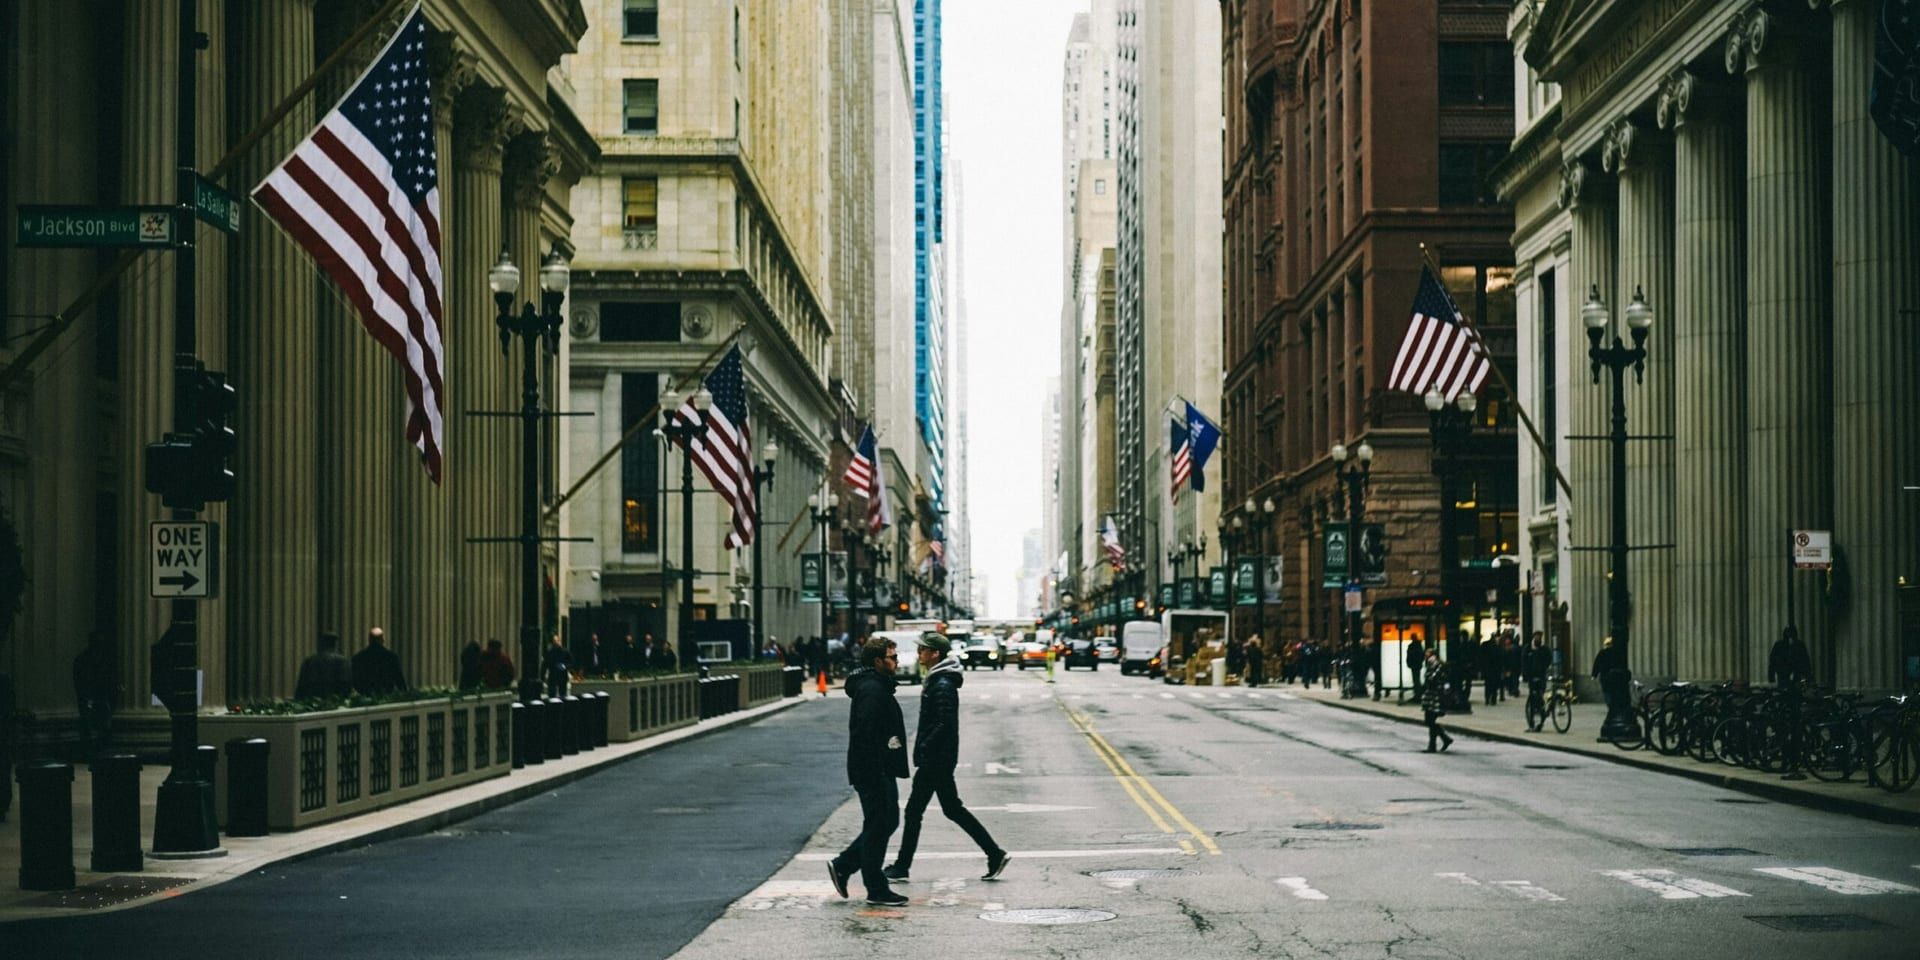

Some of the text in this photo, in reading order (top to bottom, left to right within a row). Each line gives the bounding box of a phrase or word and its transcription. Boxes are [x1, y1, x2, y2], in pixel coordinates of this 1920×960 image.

[1578, 19, 1643, 98] WINTRUST
[196, 184, 225, 219] La Salle
[23, 216, 136, 236] W Jackson Blvd
[158, 527, 202, 546] ONE
[157, 549, 203, 567] WAY
